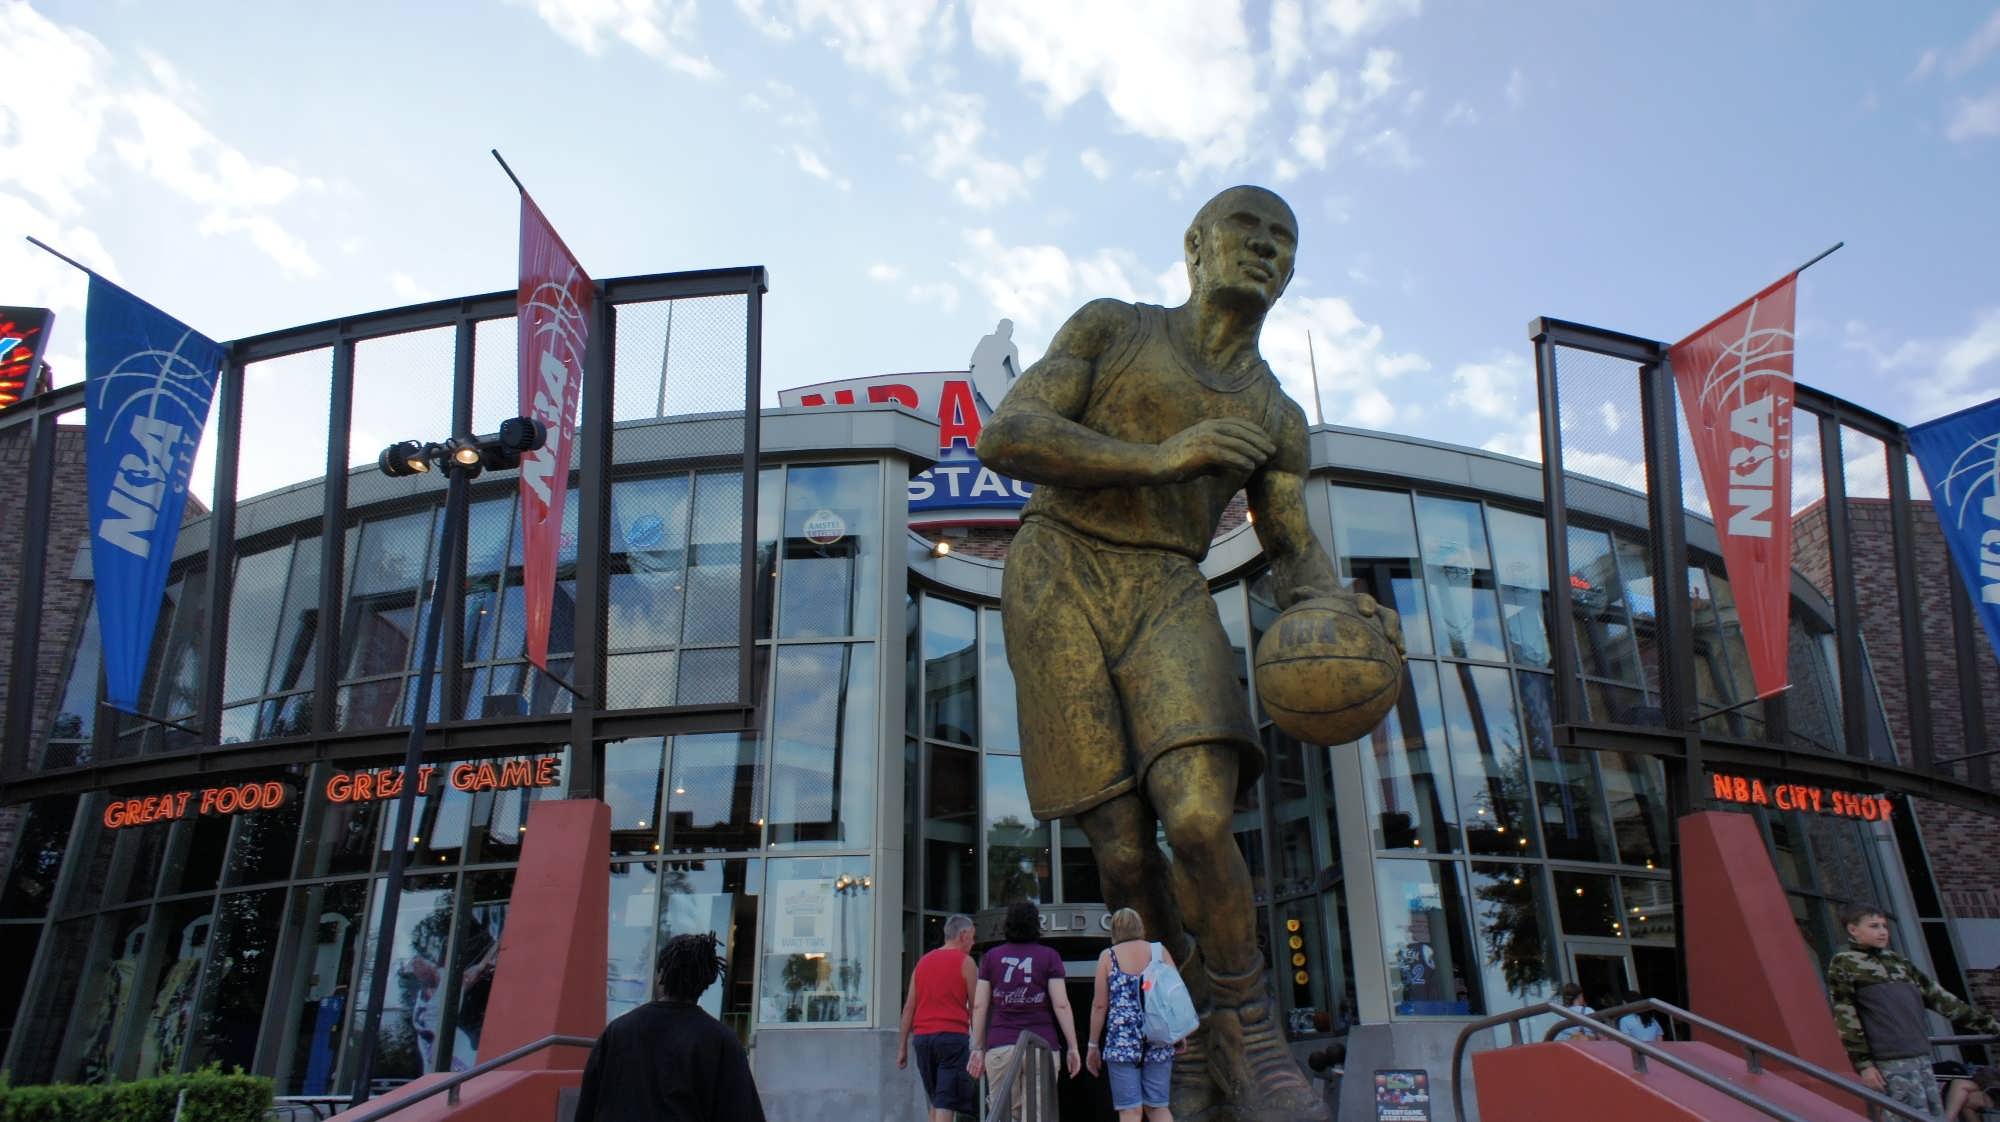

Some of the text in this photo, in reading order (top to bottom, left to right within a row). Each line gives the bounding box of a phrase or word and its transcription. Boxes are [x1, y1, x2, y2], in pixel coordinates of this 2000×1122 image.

[522, 351, 568, 507] NBA
[563, 377, 578, 440] CITY
[1777, 395, 1790, 460] CITY
[99, 415, 183, 560] NBA
[174, 433, 195, 493] CITY
[1728, 395, 1774, 538] NBA
[104, 782, 284, 828] GREAT FOOD
[451, 758, 554, 791] GAME
[1713, 773, 1892, 822] NBA CITY SHOP
[1001, 957, 1032, 983] 71
